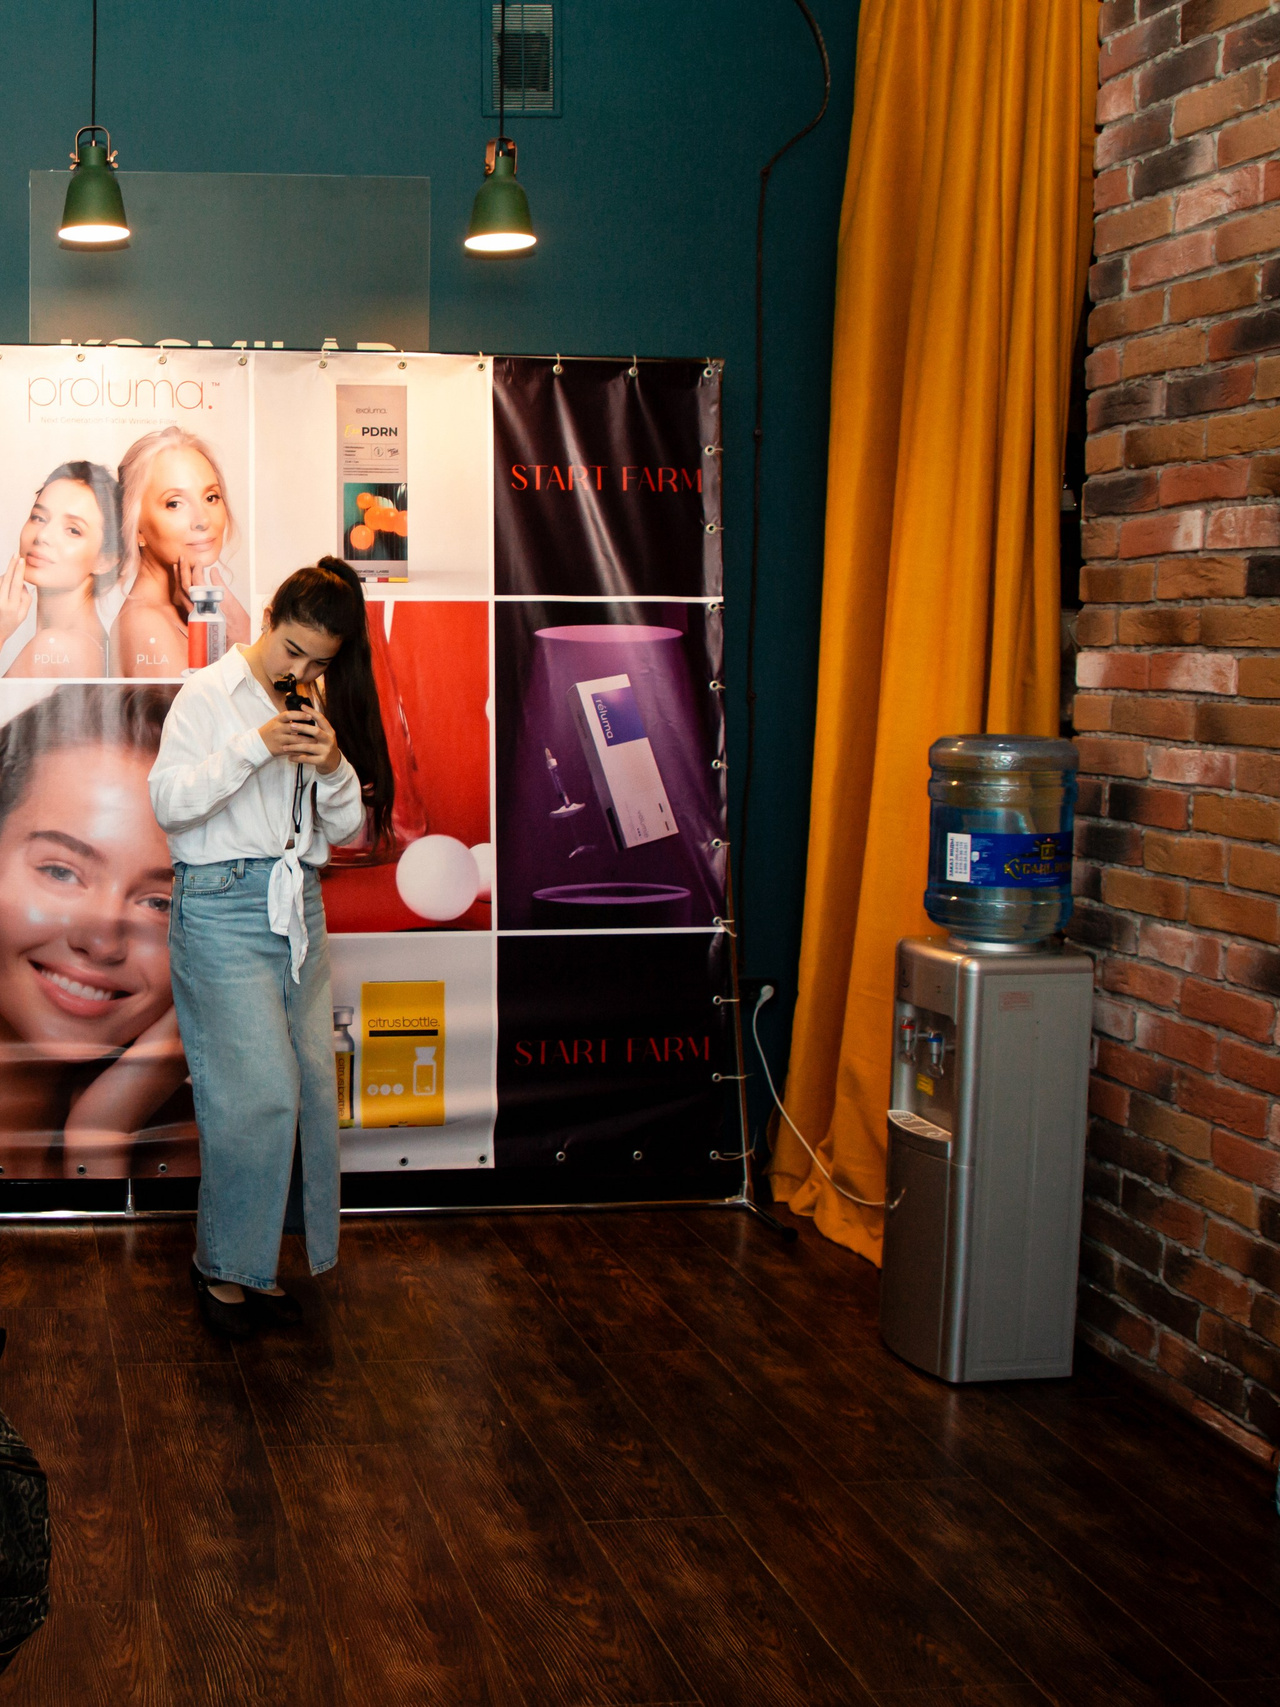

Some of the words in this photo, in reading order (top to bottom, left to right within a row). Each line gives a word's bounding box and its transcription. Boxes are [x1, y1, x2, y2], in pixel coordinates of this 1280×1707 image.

[28, 364, 213, 423] proluma.
[361, 427, 398, 437] PDRN
[511, 464, 609, 491] START
[622, 466, 702, 493] FARM
[34, 654, 70, 664] PDLLA
[136, 654, 169, 665] PLLA
[595, 699, 614, 739] réluma
[514, 1038, 614, 1066] START
[627, 1036, 710, 1063] FARM
